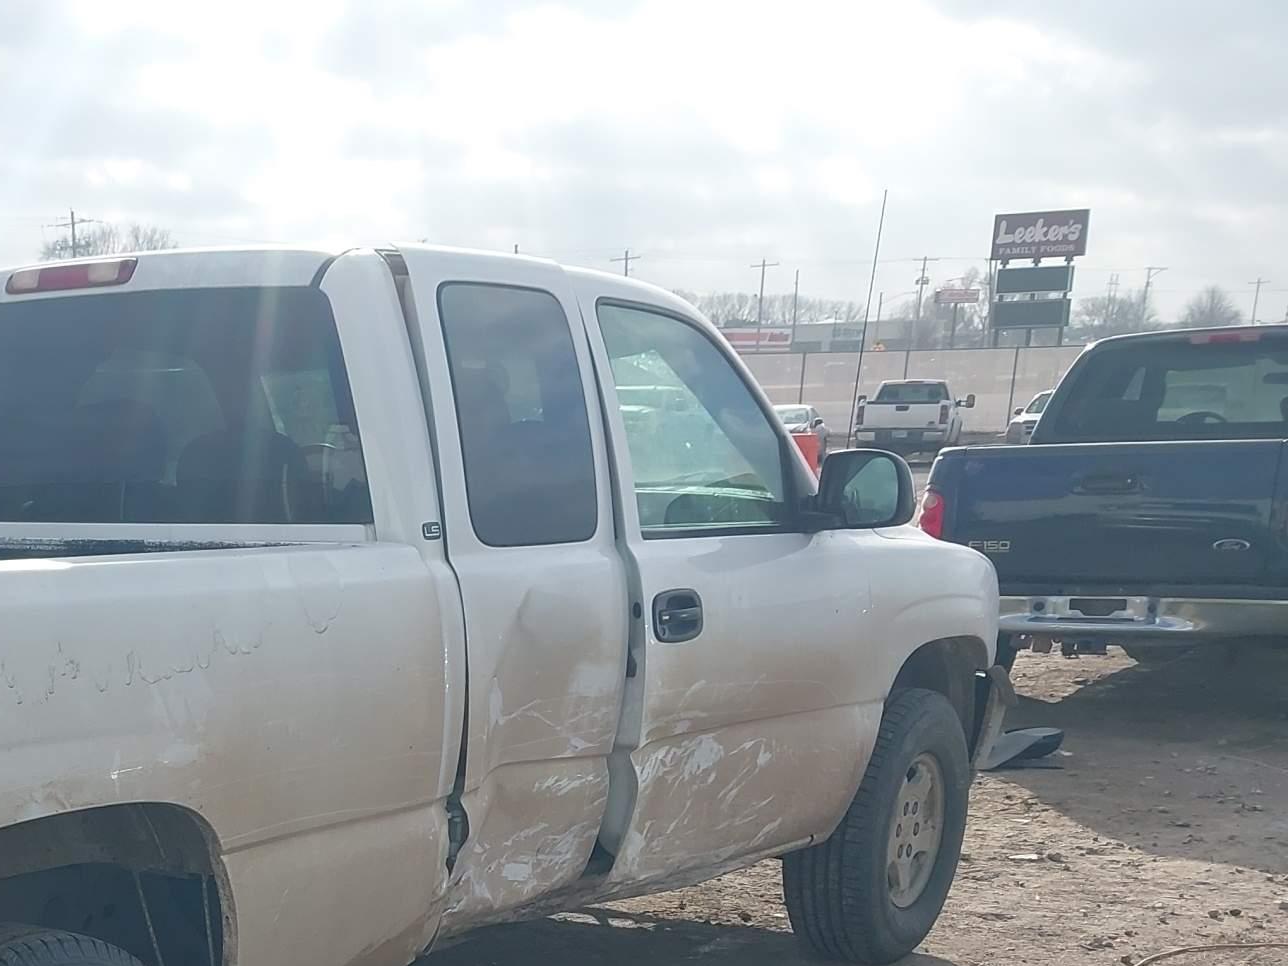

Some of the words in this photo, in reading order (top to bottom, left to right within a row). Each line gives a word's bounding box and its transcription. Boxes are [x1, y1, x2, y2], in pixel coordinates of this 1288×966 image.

[995, 218, 1083, 244] Leeker's
[999, 246, 1037, 255] FAMILY
[424, 525, 440, 537] LS
